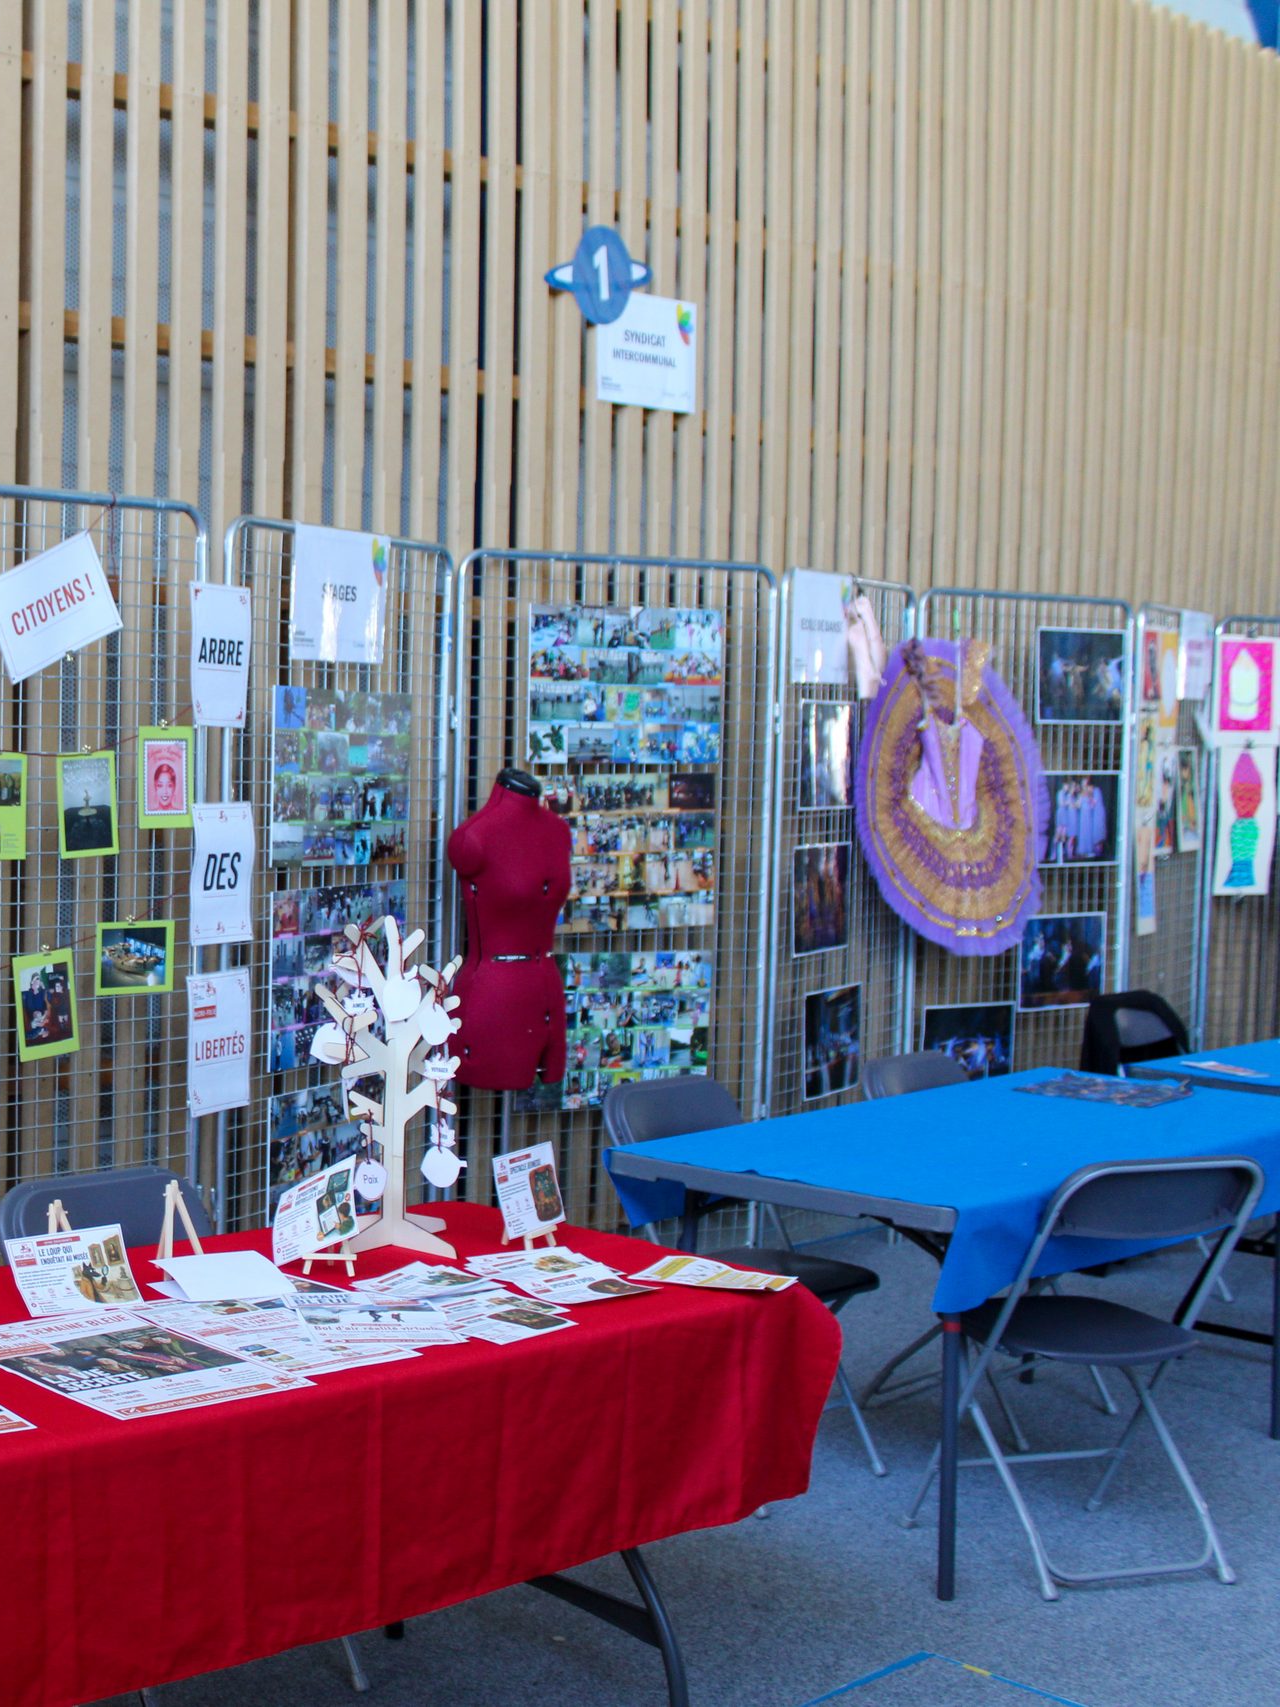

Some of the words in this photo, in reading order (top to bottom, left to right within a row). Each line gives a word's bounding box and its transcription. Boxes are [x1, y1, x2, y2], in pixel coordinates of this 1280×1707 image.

[593, 245, 609, 301] 1
[624, 330, 665, 347] SYNDICAT
[613, 348, 677, 368] INTERCOMMUNAL
[11, 577, 87, 636] CITOYENS
[198, 637, 243, 667] ARBRE
[203, 851, 242, 892] DES
[195, 1030, 245, 1061] LIBERTÉS
[363, 1175, 378, 1184] Paix
[26, 1321, 87, 1335] SEMAINE
[41, 1374, 77, 1384] LA
